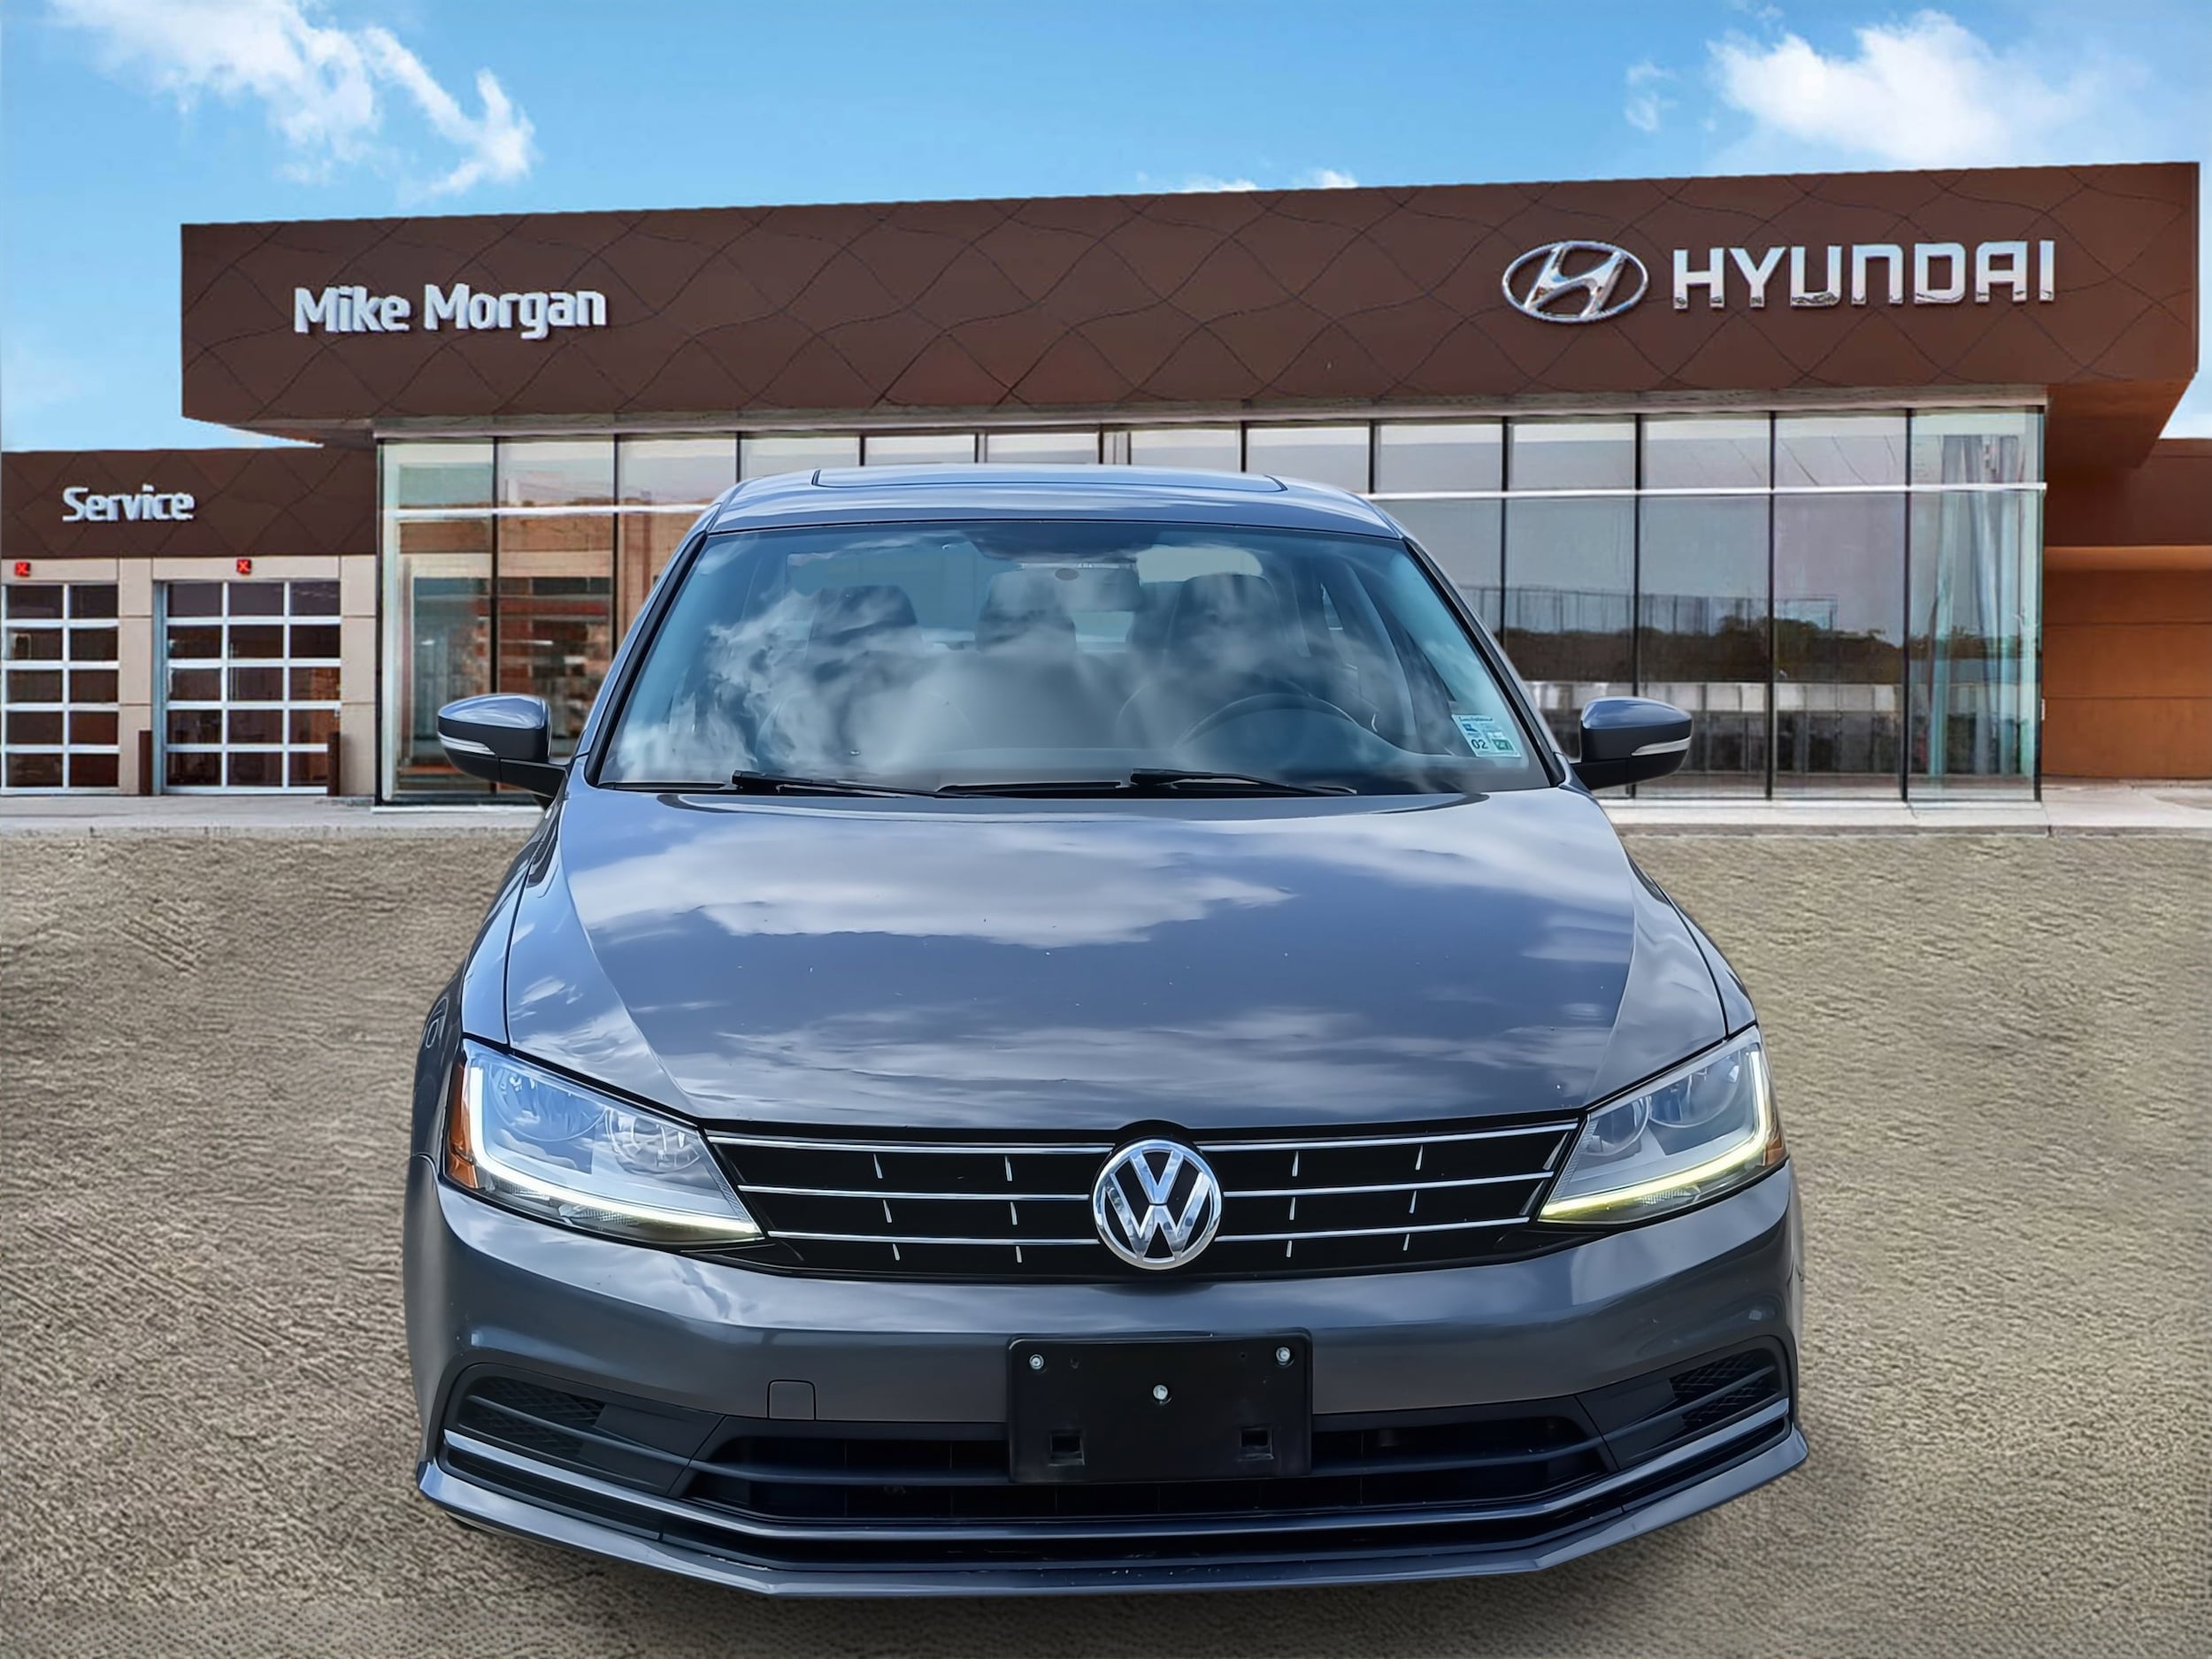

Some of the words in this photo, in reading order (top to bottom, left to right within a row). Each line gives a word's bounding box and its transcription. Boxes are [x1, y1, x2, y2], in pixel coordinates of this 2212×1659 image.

[1672, 240, 2055, 310] HYUNDAI
[294, 285, 411, 334] Mike
[424, 283, 607, 340] Morgan
[62, 484, 195, 521] Service
[1471, 739, 1488, 749] 02
[1102, 1146, 1215, 1261] VW
